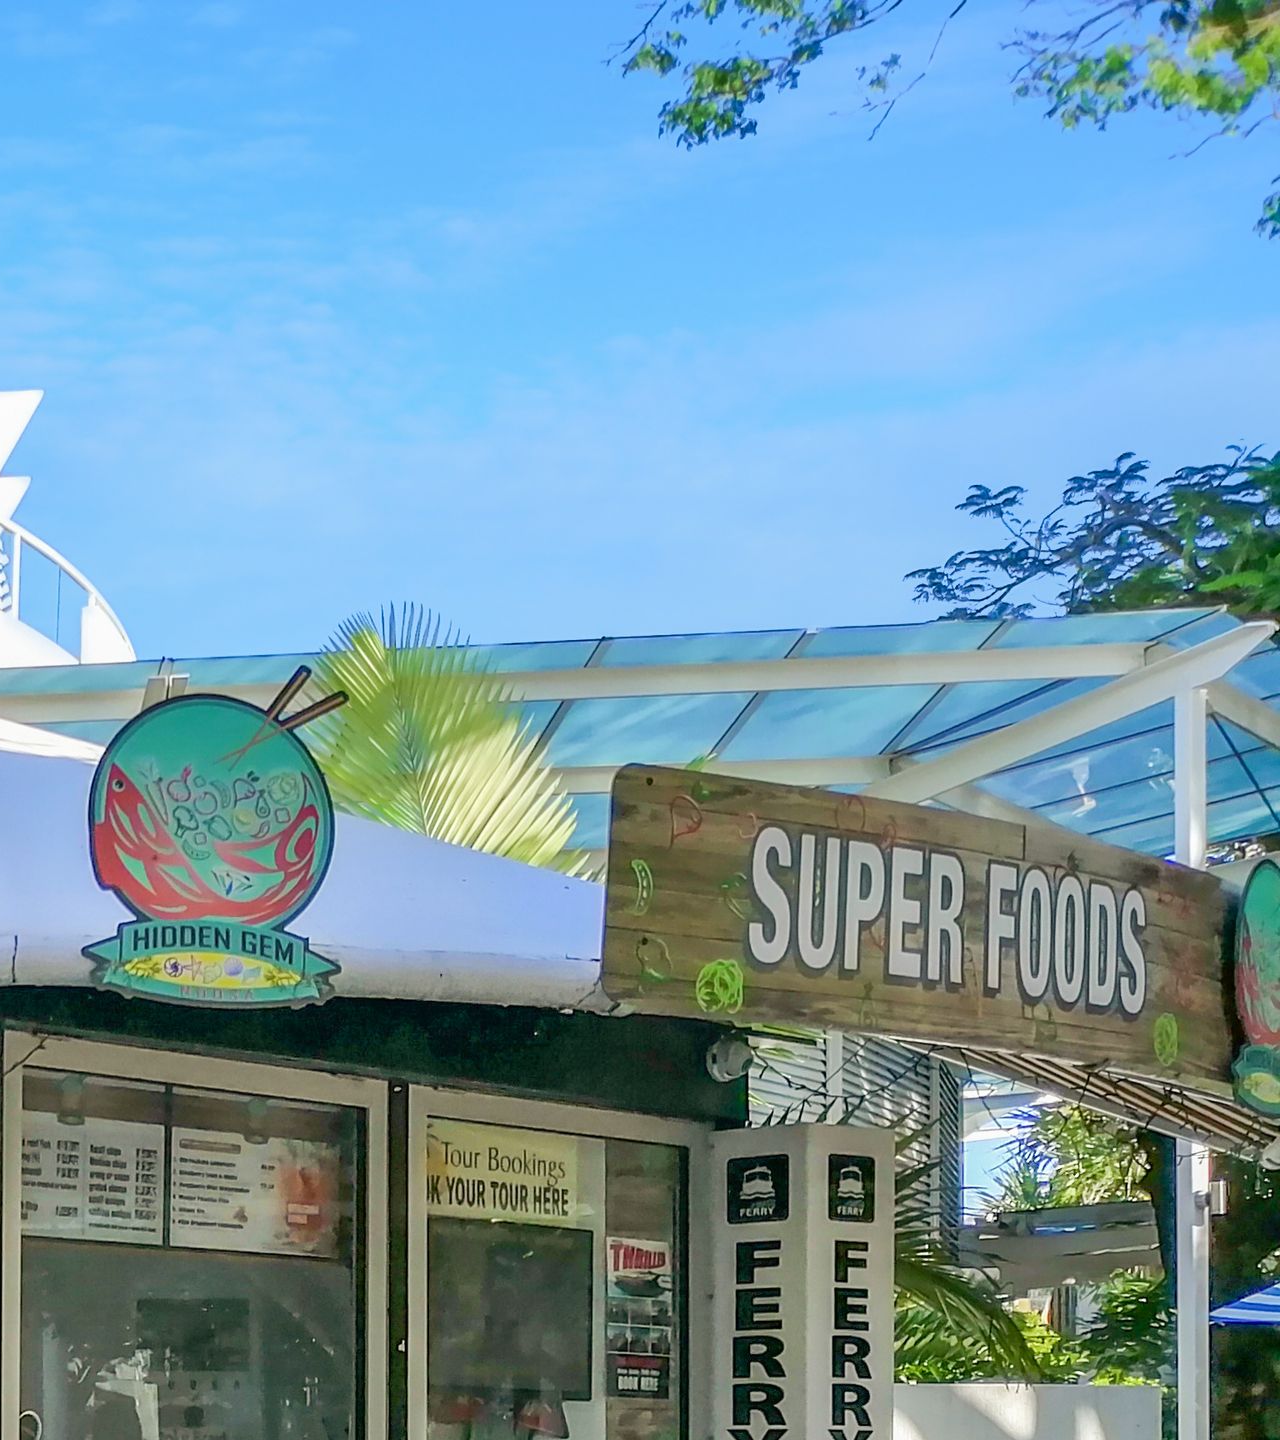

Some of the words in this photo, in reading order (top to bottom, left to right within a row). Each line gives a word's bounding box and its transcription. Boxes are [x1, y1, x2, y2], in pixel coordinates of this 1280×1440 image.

[747, 825, 966, 989] SUPER
[984, 858, 1147, 1017] FOODS
[133, 925, 231, 951] HIDDEN
[241, 930, 294, 965] GEM
[441, 1141, 480, 1169] Tour
[488, 1147, 566, 1187] Bookings
[446, 1175, 486, 1209] YOUR
[491, 1181, 528, 1213] TOUR
[533, 1185, 569, 1217] HERE
[740, 1206, 774, 1218] FERRY
[837, 1206, 864, 1217] FERRY
